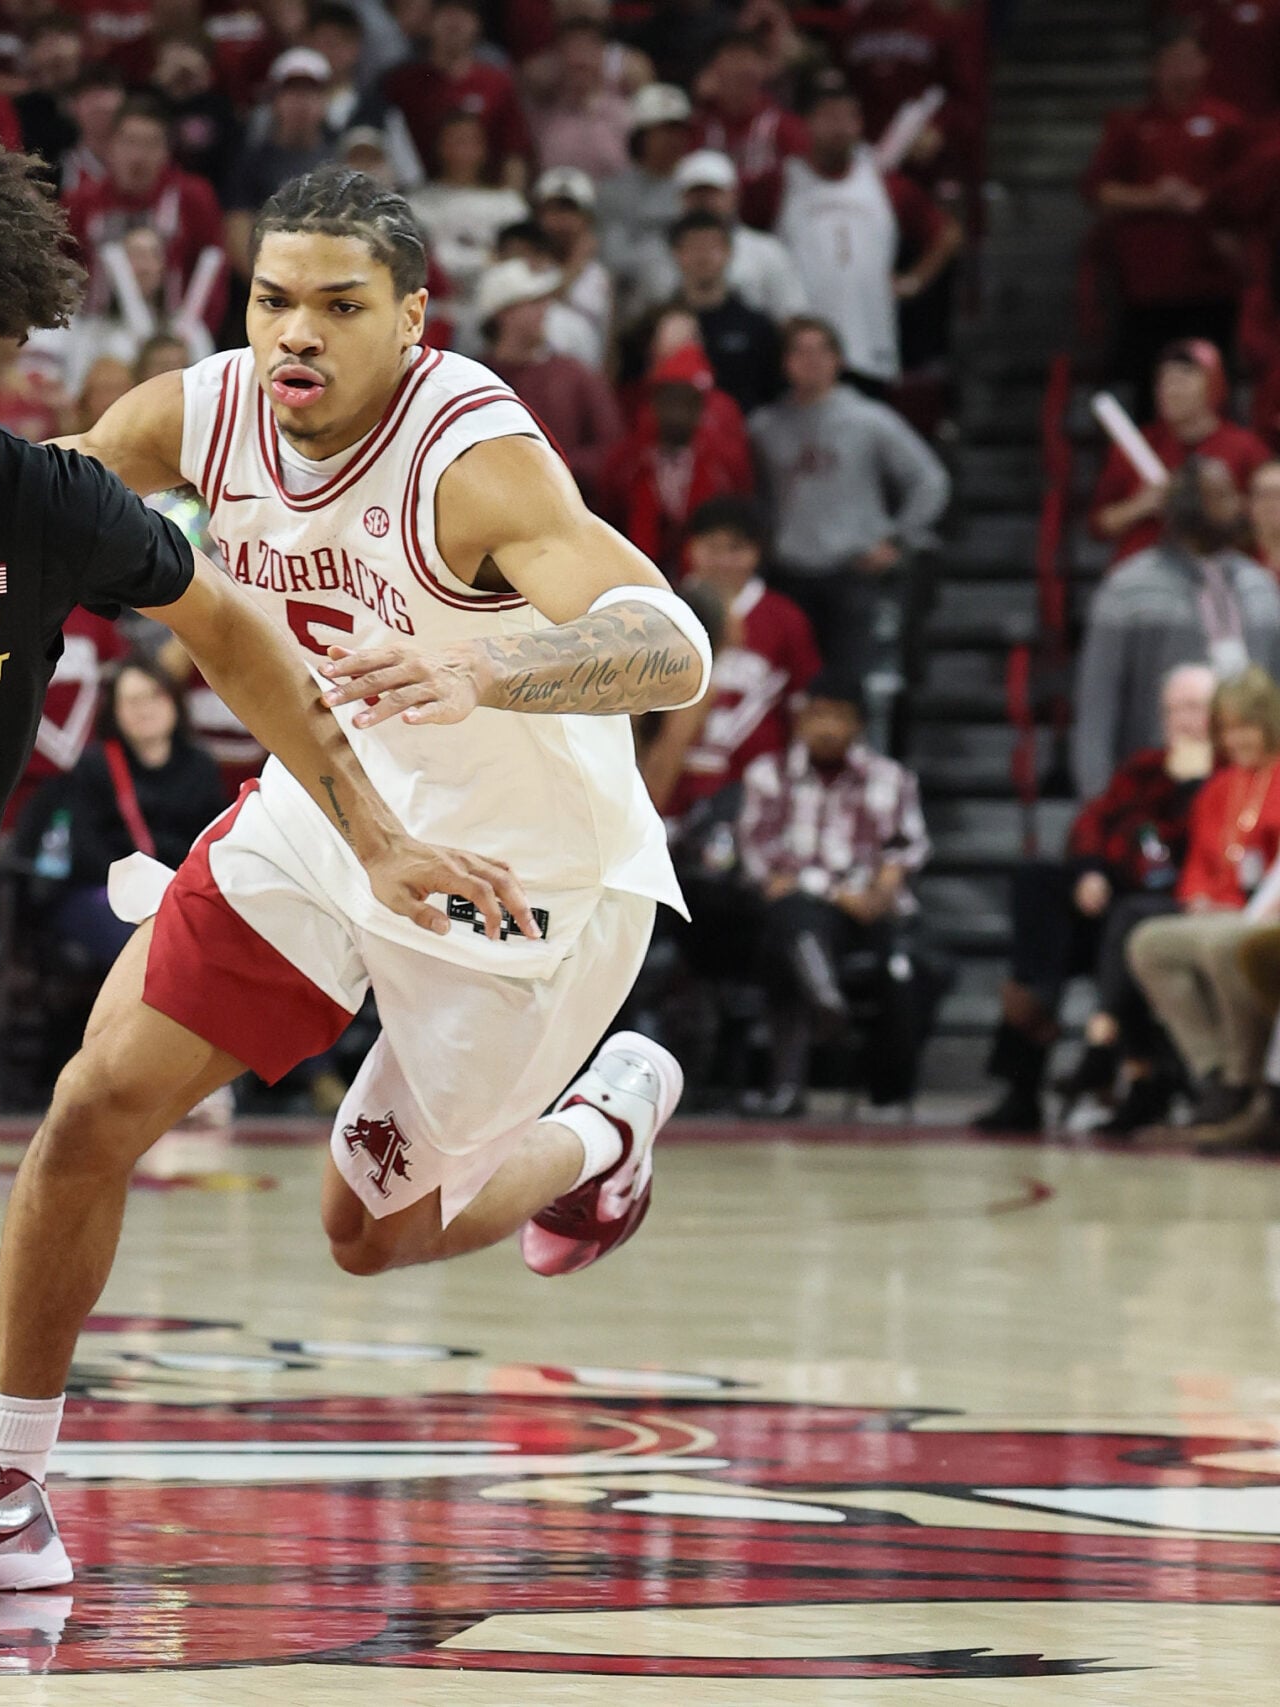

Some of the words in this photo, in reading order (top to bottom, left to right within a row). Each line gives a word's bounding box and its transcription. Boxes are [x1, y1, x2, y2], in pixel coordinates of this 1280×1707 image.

[365, 507, 388, 536] SEC
[506, 668, 563, 706] Fear
[570, 655, 622, 695] No
[625, 648, 691, 685] Man
